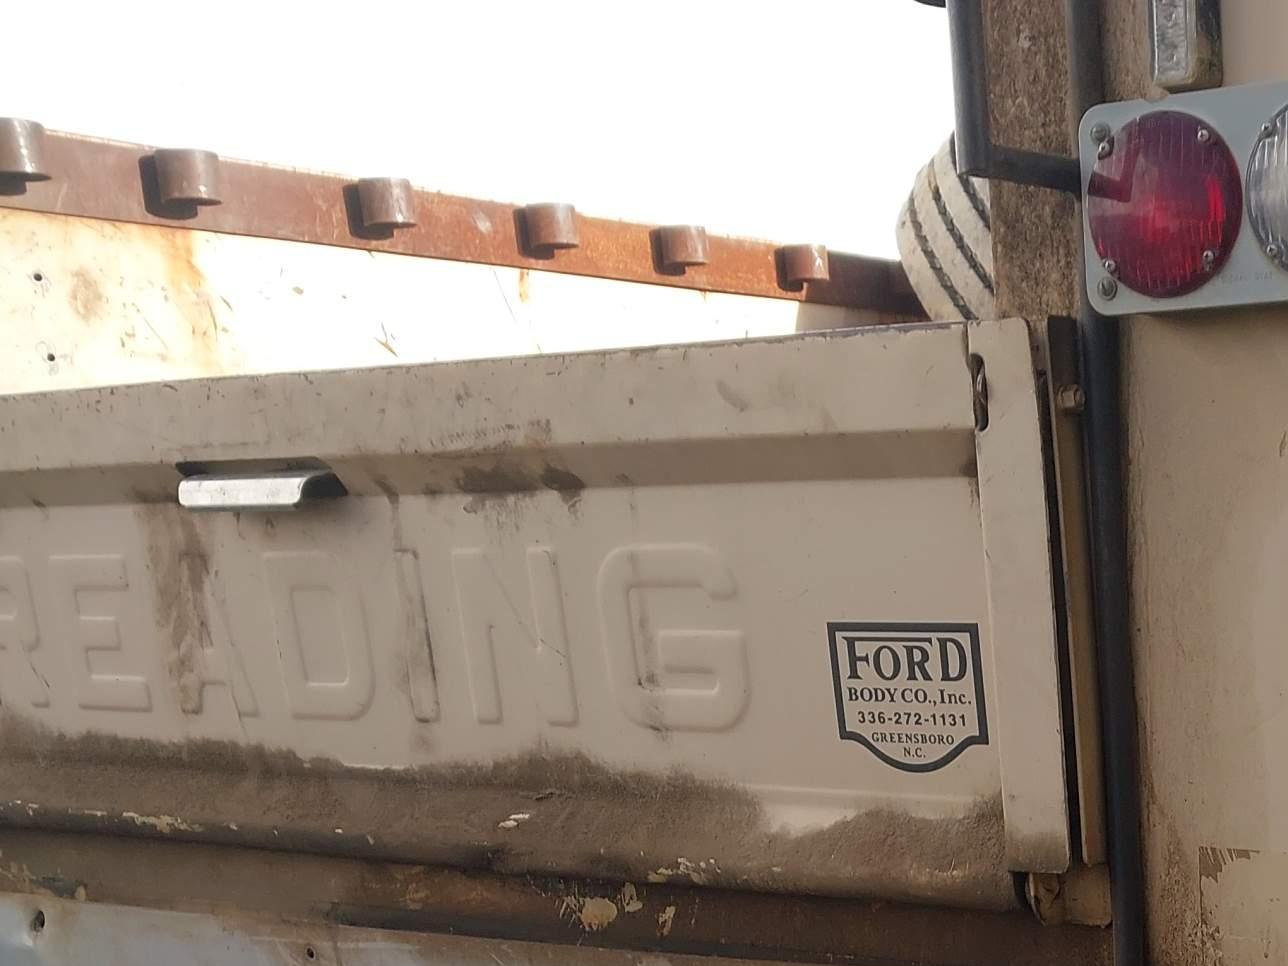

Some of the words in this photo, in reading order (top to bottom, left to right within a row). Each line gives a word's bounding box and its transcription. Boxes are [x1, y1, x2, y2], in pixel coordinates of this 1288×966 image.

[842, 636, 968, 682] FORD
[847, 686, 898, 703] BODY
[938, 688, 972, 705] Inc.
[857, 710, 967, 727] 336-272-1131
[871, 731, 955, 746] GREENSBORO
[903, 747, 926, 759] N.C.
